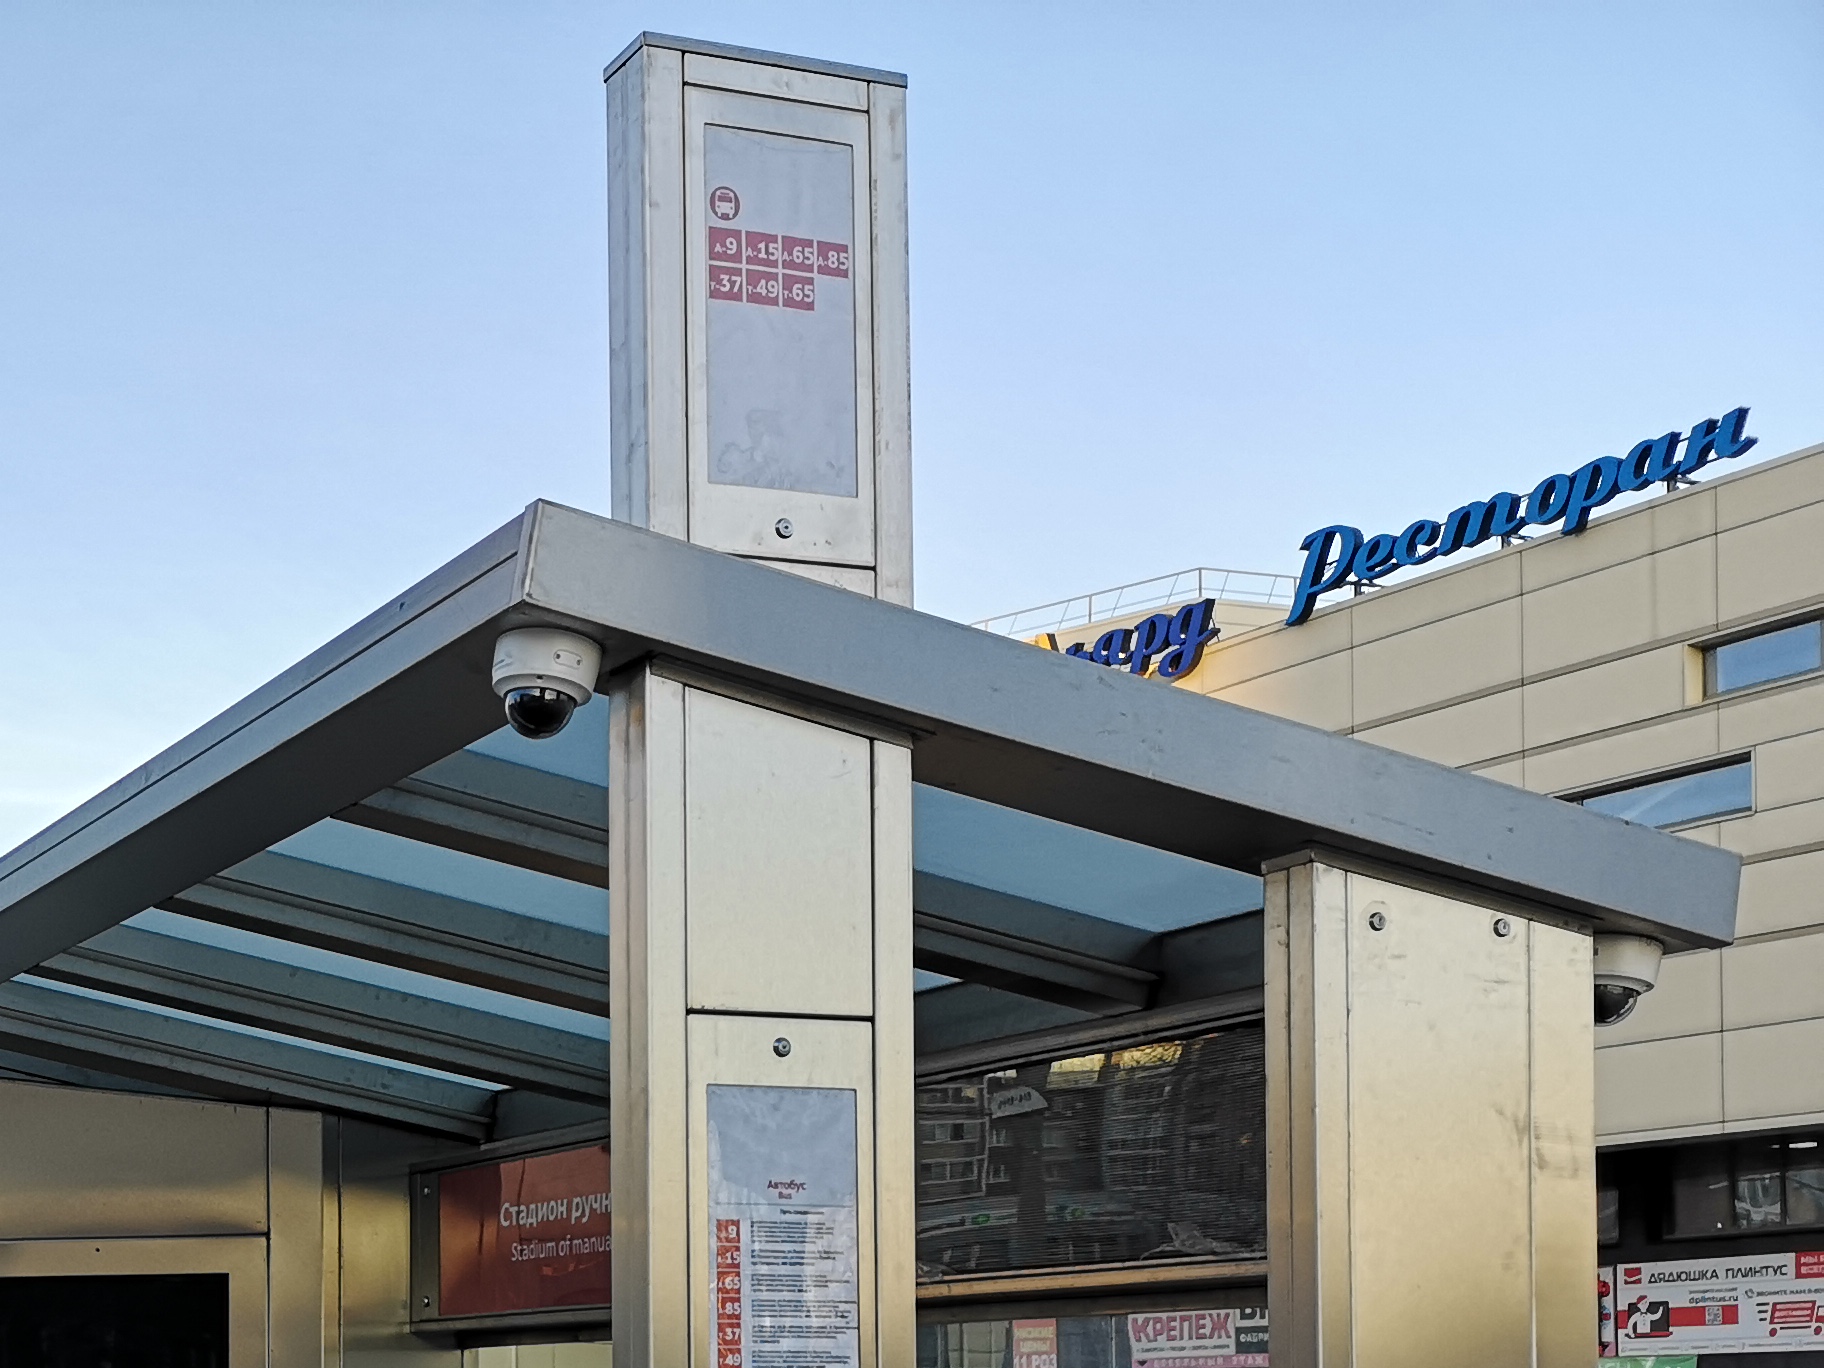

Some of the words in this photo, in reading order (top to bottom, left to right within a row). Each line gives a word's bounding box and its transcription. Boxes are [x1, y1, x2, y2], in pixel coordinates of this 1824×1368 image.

[1287, 406, 1759, 627] Ресторан
[767, 1180, 807, 1192] Автобус
[500, 1199, 568, 1228] Стадион
[511, 1239, 556, 1261] Stadium
[558, 1234, 571, 1256] of
[1648, 1269, 1719, 1284] ДЯДЮШКА
[1725, 1264, 1788, 1280] ПЛИНТУС
[1131, 1312, 1232, 1343] КРЕПЕЖ
